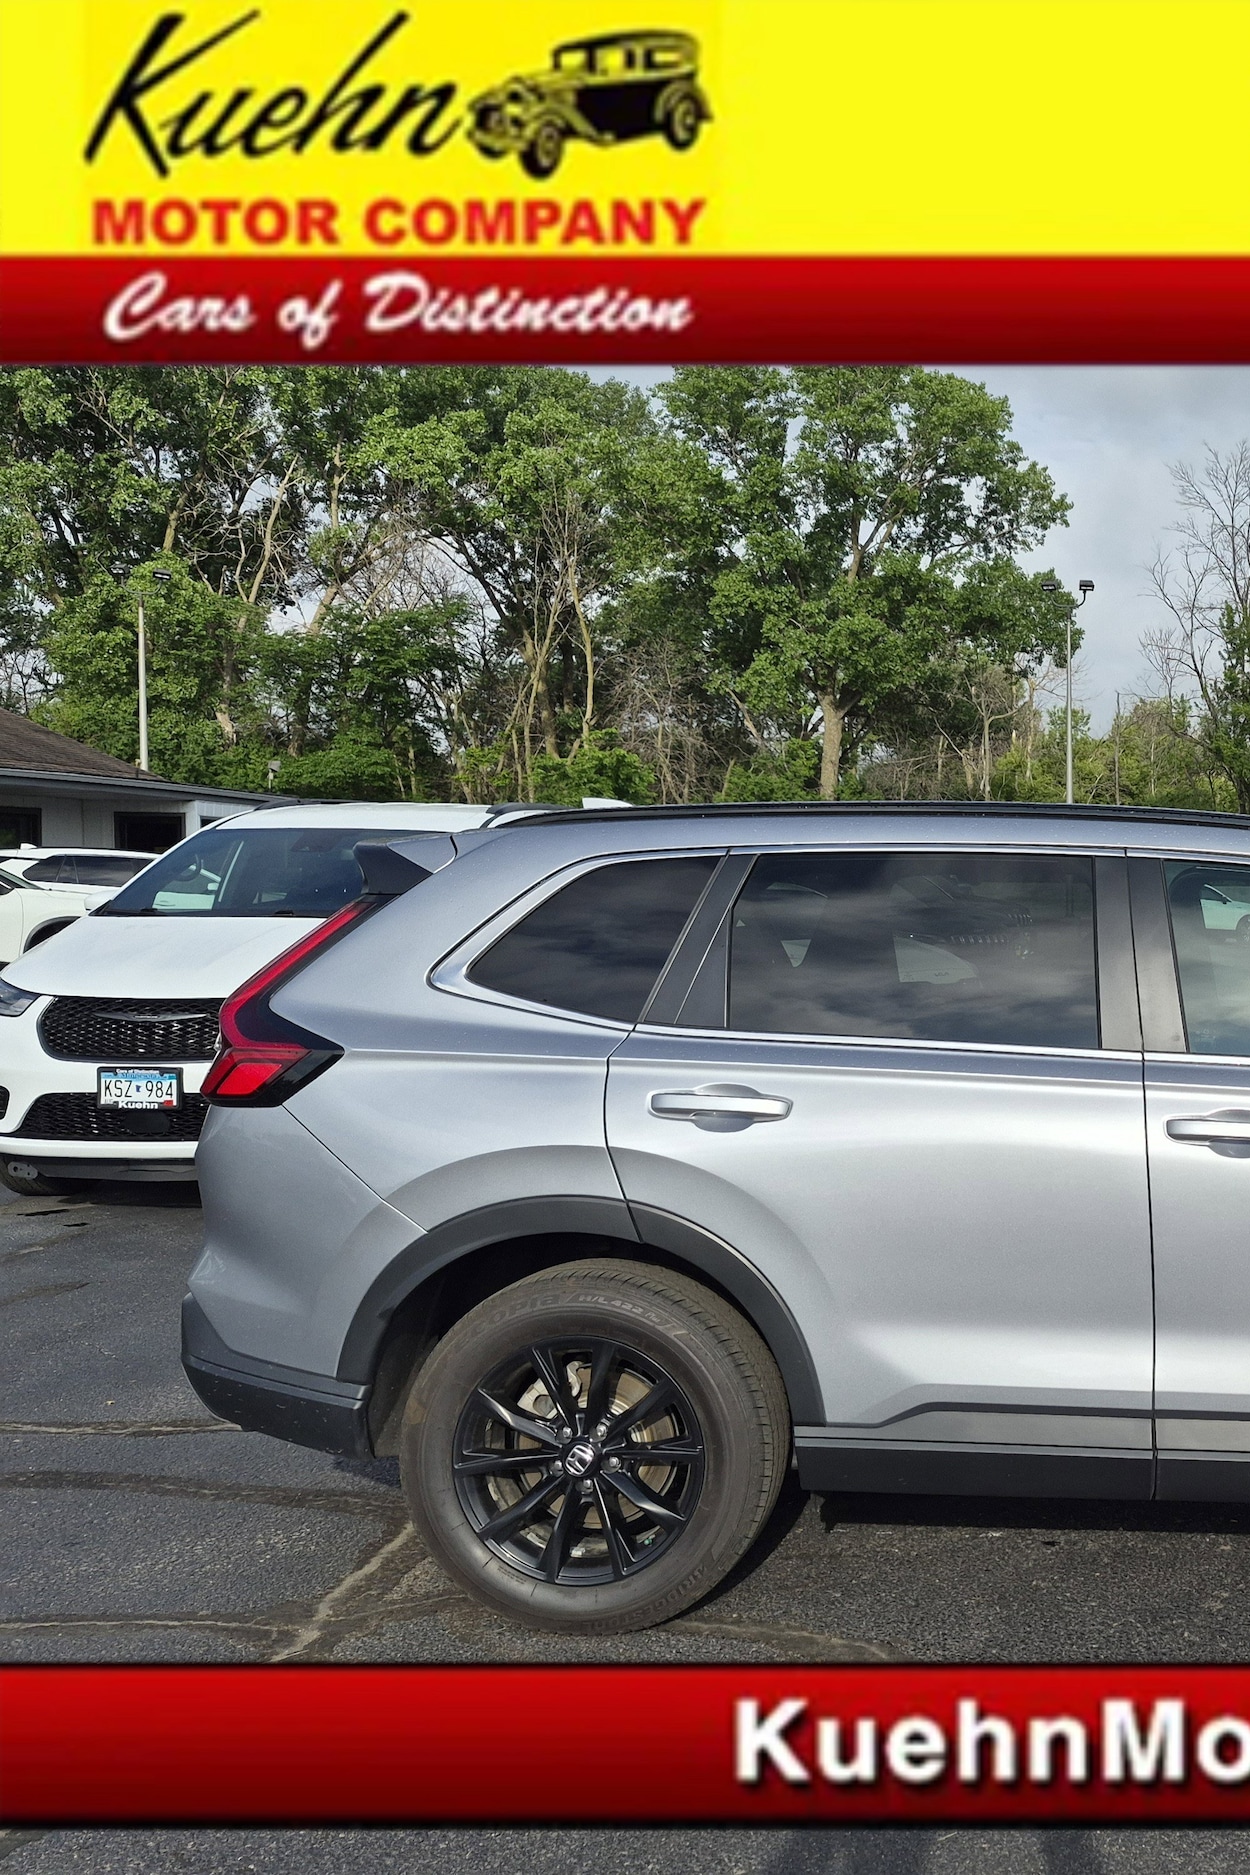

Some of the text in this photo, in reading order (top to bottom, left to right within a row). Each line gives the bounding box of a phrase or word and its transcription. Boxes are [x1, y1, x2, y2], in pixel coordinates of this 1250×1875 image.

[104, 1079, 173, 1099] KSZ 984
[118, 1101, 159, 1109] Kuehn
